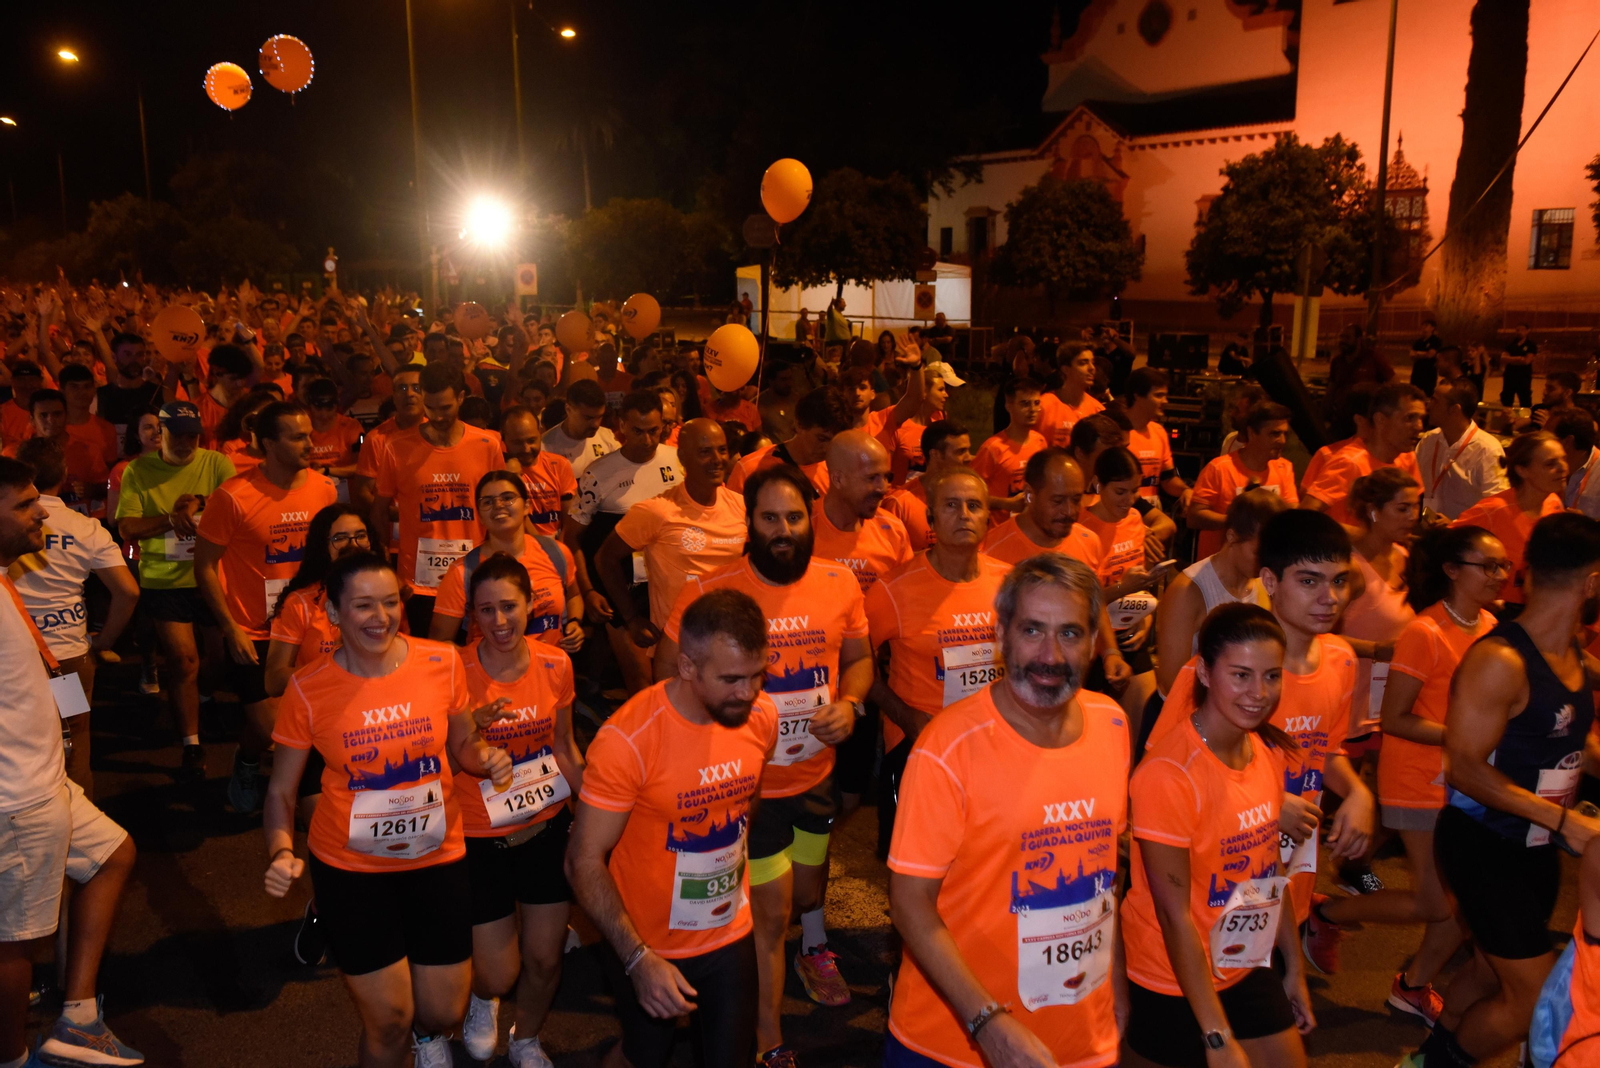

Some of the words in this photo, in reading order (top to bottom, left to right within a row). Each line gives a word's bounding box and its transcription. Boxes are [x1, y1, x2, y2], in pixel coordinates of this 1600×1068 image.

[432, 473, 460, 482] XXXV
[280, 511, 309, 522] XXXV
[46, 534, 74, 550] FF
[1118, 600, 1148, 611] 12868
[767, 615, 808, 632] XXXV
[952, 612, 991, 627] XXXV
[788, 629, 826, 638] NOCTURNA
[960, 666, 1005, 686] 15289
[362, 702, 411, 726] XXXV
[1284, 715, 1322, 732] XXXV
[342, 726, 383, 739] CARRERA
[386, 716, 431, 730] NOCTURNA
[350, 723, 432, 747] GUADALQUIVIR
[481, 726, 514, 734] CARRERA
[517, 716, 552, 729] NOCTURNA
[486, 723, 552, 741] GUADALQUIVIR
[780, 718, 812, 736] 377
[351, 751, 373, 762] KH7
[698, 759, 741, 786] XXXV
[677, 785, 716, 799] CARRERA
[719, 774, 756, 790] NOCTURNA
[684, 782, 756, 808] GUADALQUIVIR
[504, 784, 555, 812] 12619
[1043, 798, 1095, 825] XXXV
[1237, 801, 1271, 831] XXXV
[370, 814, 430, 837] 12617
[1022, 826, 1061, 840] CARRERA
[1065, 819, 1112, 832] NOCTURNA
[1028, 828, 1111, 850] GUADALQUIVIR
[1220, 831, 1254, 845] CARRERA
[707, 870, 738, 896] 934
[1219, 912, 1269, 932] 15733
[1042, 929, 1102, 965] 18643
